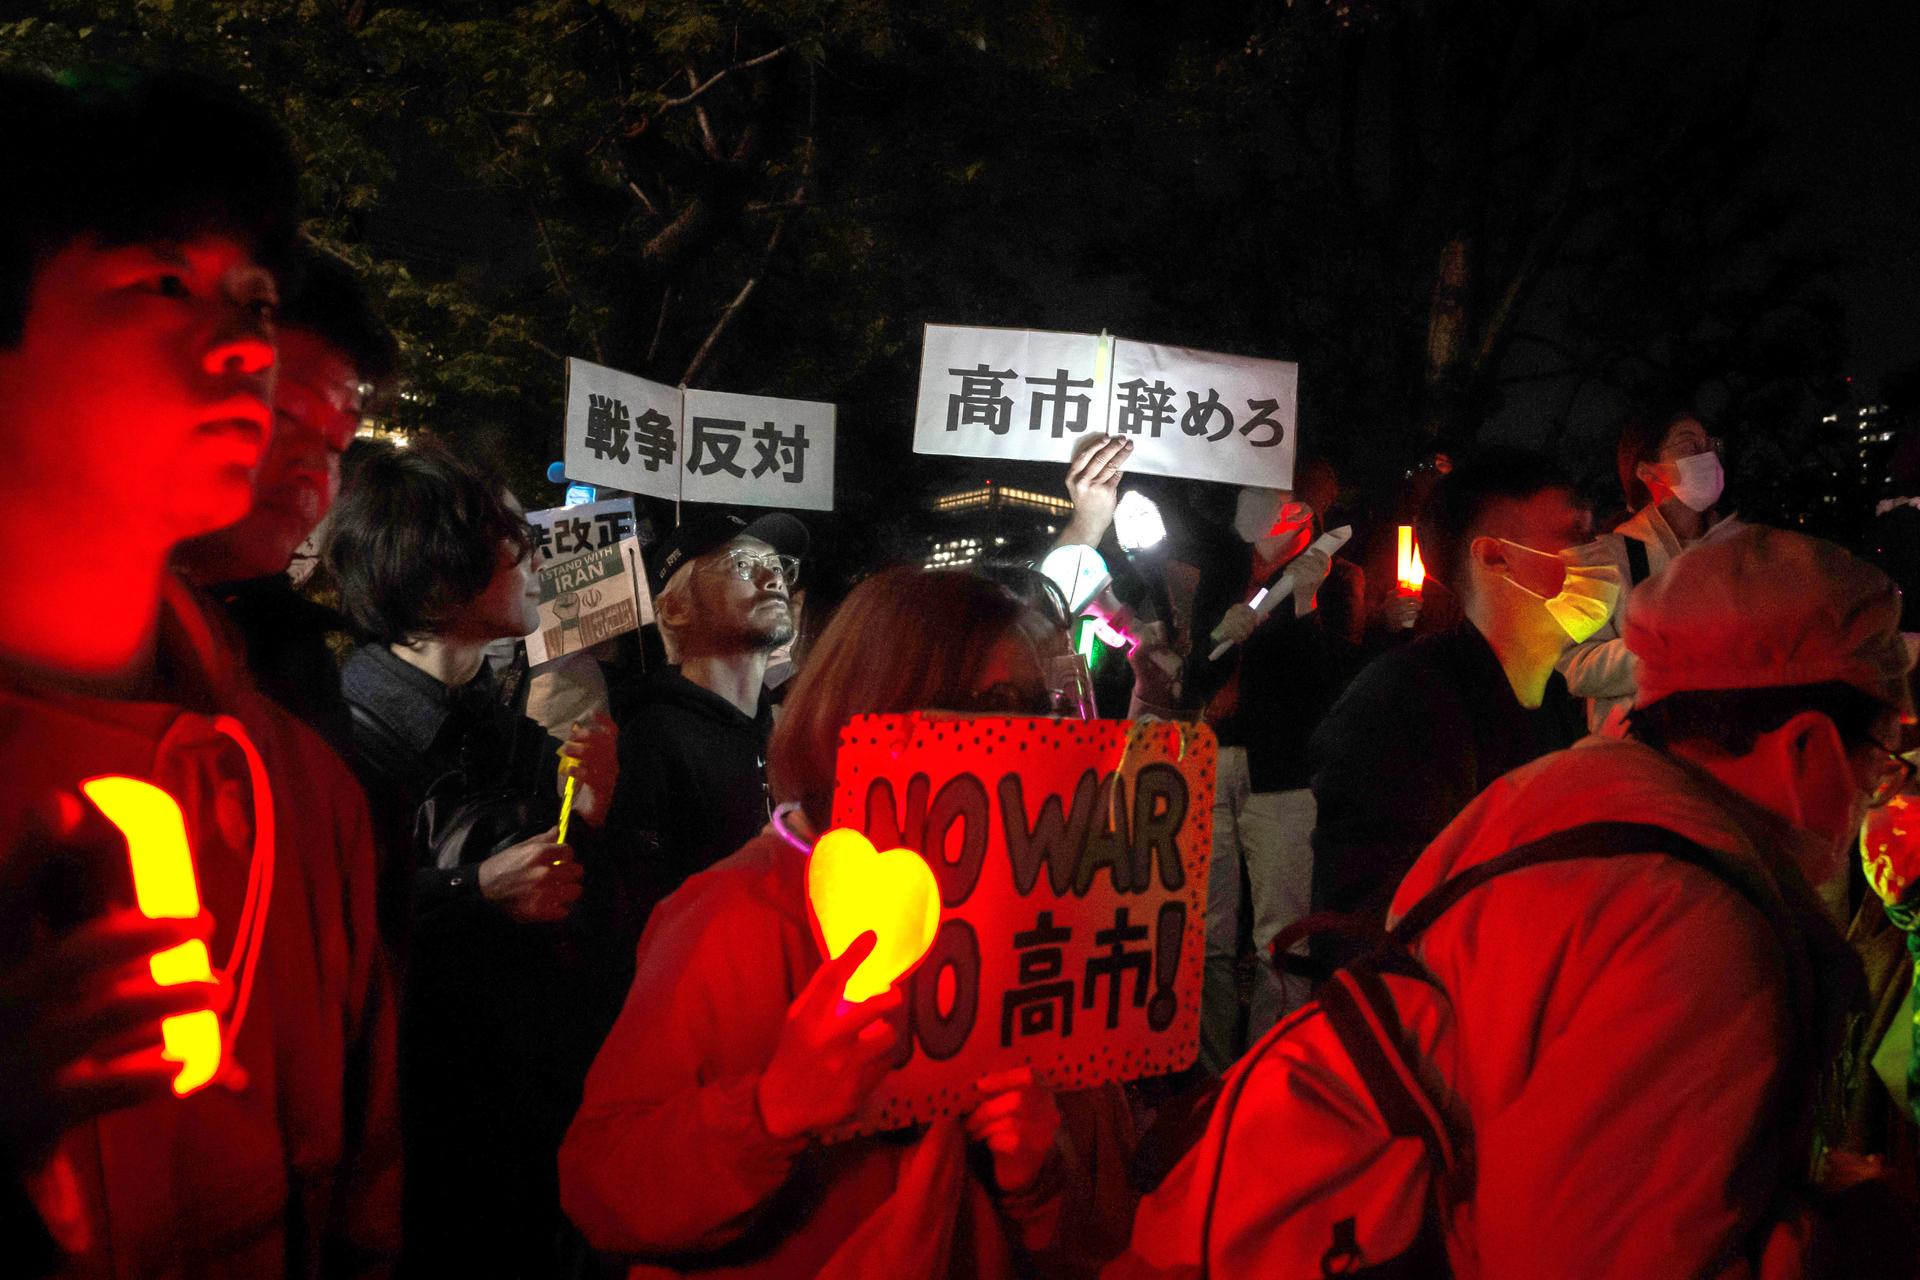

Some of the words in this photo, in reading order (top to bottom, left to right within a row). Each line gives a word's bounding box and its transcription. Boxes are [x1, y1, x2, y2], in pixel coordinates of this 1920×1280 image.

[585, 393, 810, 483] 戦争反対
[946, 364, 1286, 447] 高市辞めろ
[545, 558, 582, 580] STAND
[584, 546, 613, 564] WITH
[555, 561, 604, 594] IRAN
[998, 762, 1189, 898] WAR
